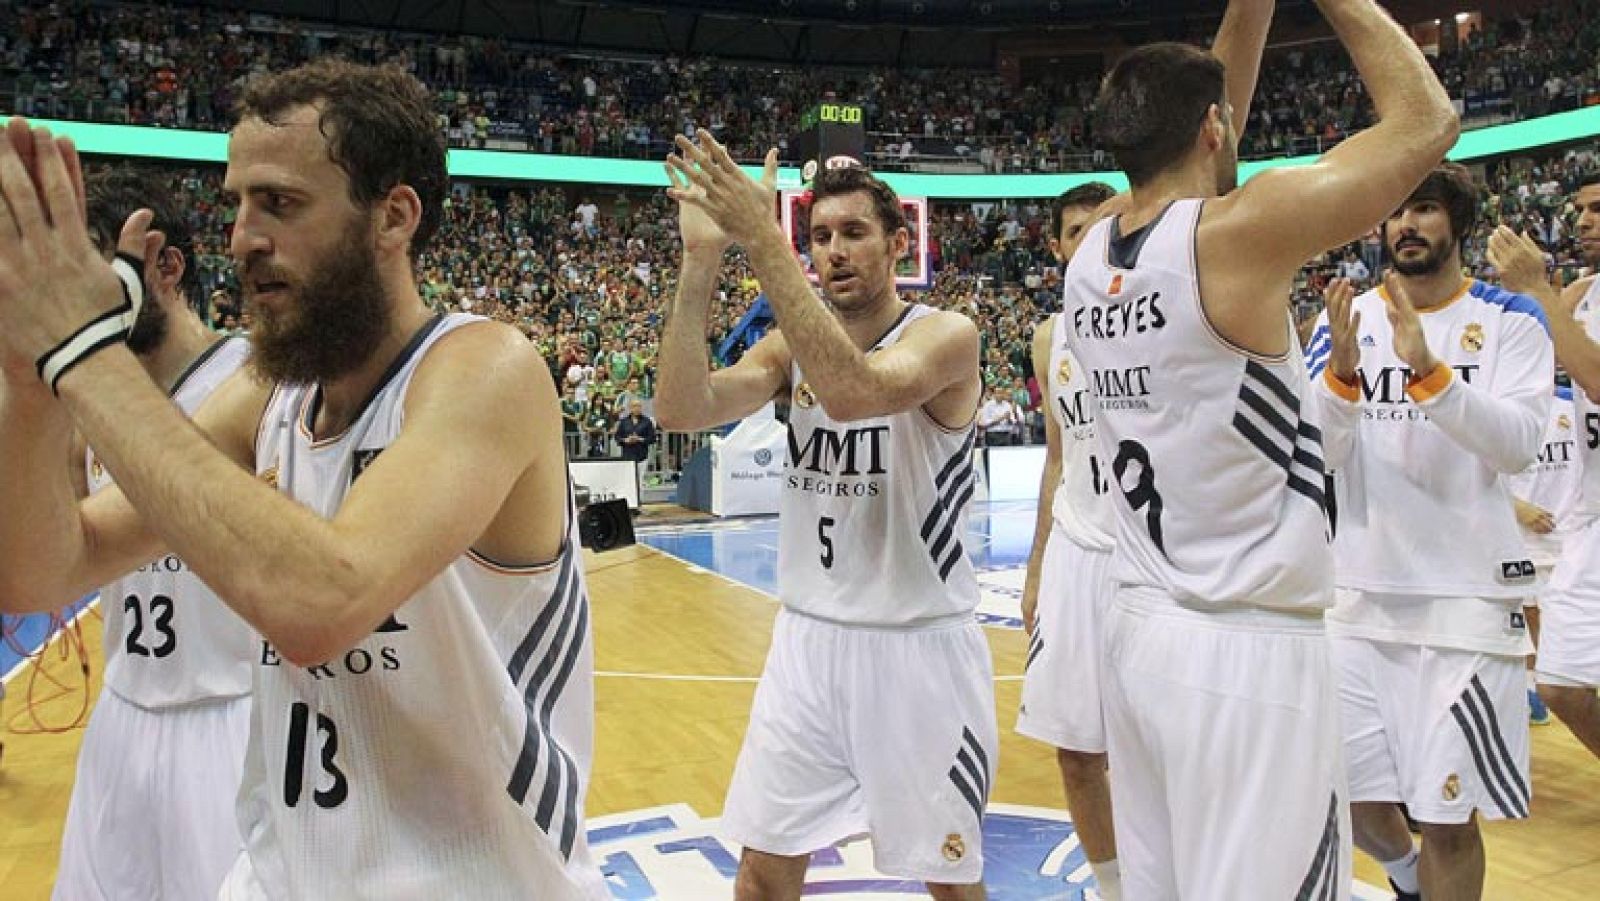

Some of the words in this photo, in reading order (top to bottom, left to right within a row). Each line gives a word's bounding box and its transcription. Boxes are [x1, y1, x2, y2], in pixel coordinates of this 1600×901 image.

[820, 103, 862, 124] 00:00
[1074, 291, 1167, 339] F.REYES
[1092, 365, 1150, 398] MMT
[1363, 408, 1429, 421] SEGU
[784, 424, 890, 476] MMT
[1112, 439, 1168, 560] 9
[818, 516, 835, 569] 5
[125, 594, 176, 658] 23
[283, 702, 349, 810] 13
